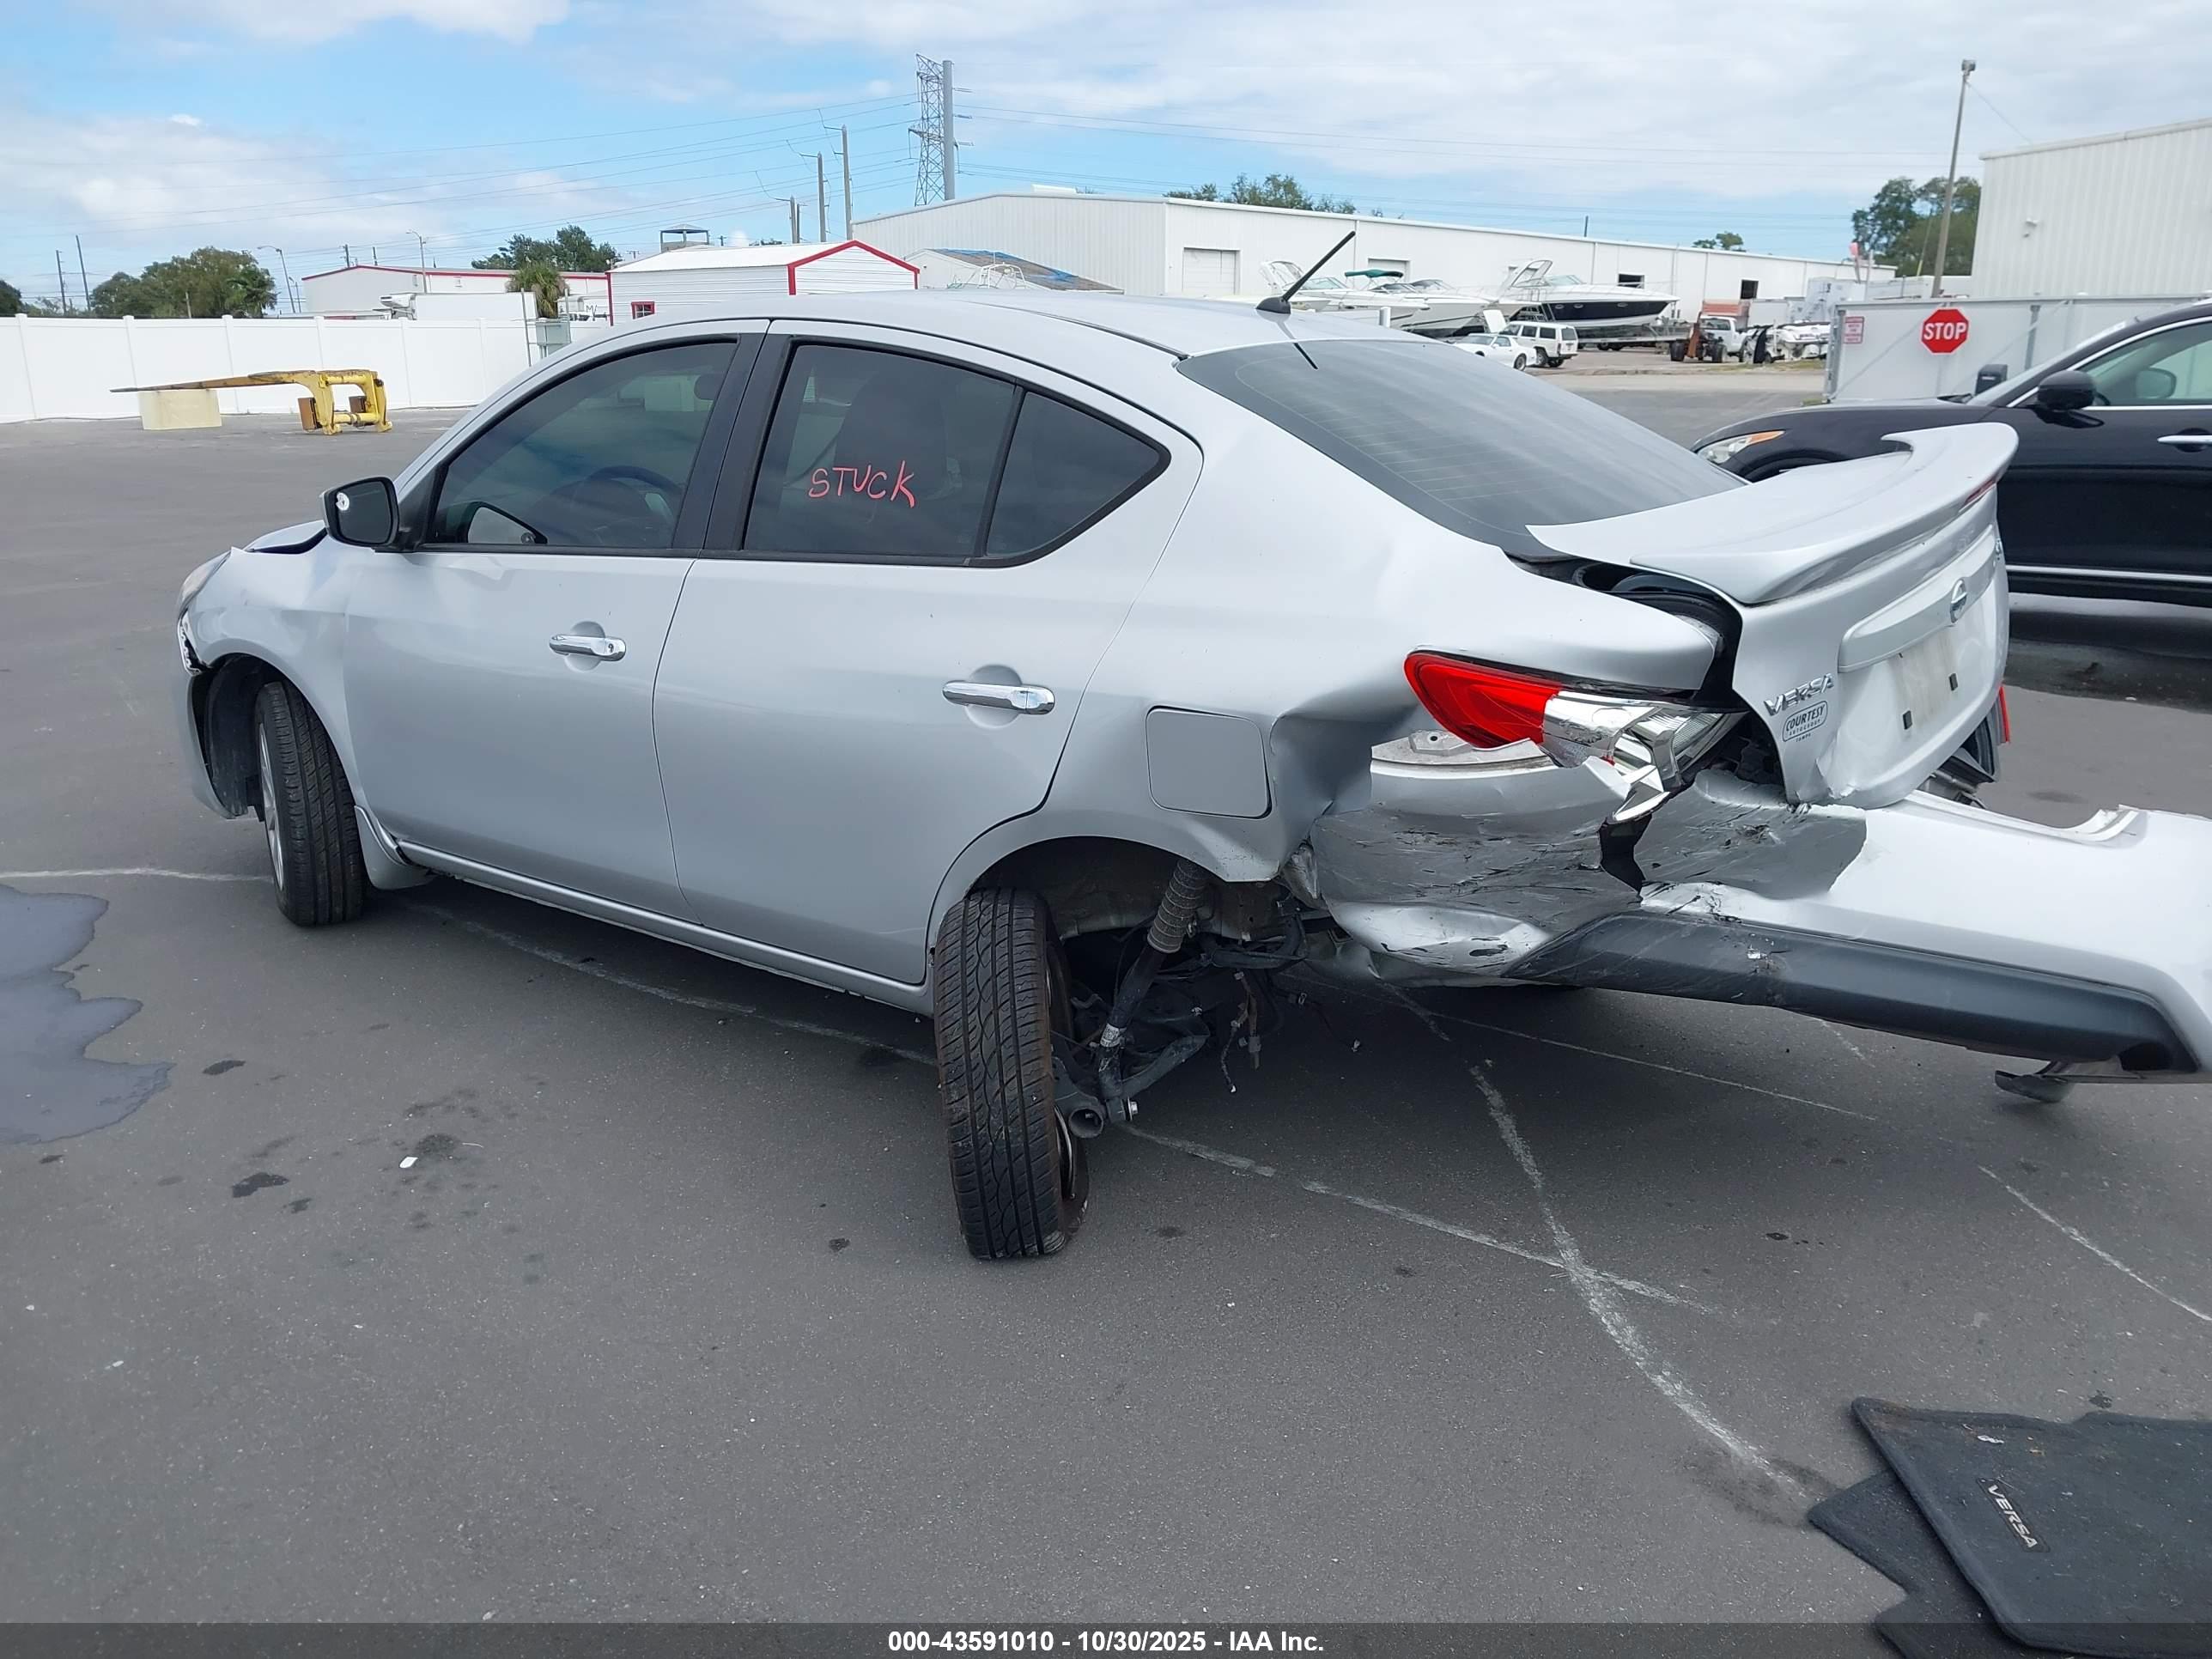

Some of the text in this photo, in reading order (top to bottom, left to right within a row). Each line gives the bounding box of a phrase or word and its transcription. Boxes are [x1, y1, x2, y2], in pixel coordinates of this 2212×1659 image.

[1923, 322, 1966, 340] STOP
[808, 459, 916, 508] STUCK
[1763, 672, 1834, 716] VERSA
[1786, 703, 1826, 732] COURTESY
[1988, 1485, 2038, 1548] VERSA
